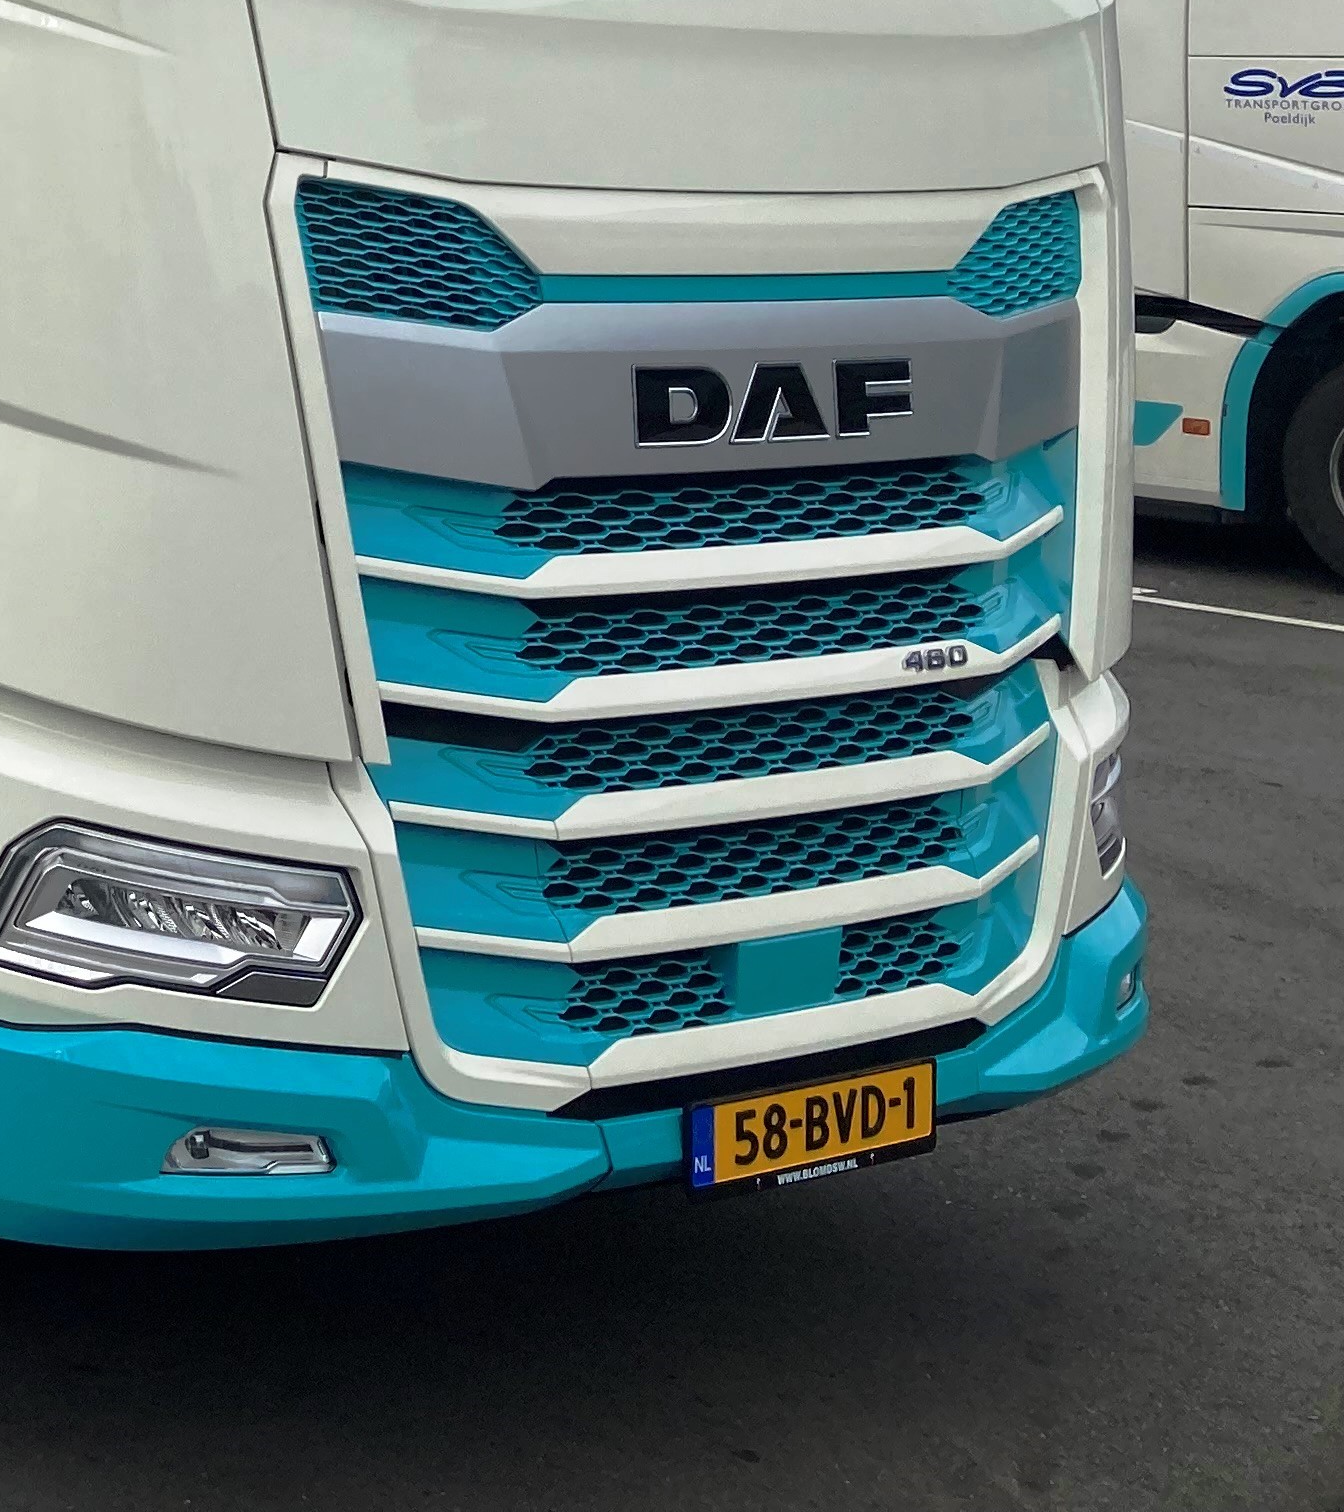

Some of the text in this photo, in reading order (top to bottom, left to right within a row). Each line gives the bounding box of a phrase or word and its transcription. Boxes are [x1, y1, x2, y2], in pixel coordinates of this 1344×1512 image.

[1223, 69, 1344, 98] SVB
[1264, 111, 1316, 127] Poeldijk
[631, 357, 914, 448] DAF
[734, 1076, 916, 1166] 58-BVD-1
[694, 1155, 712, 1174] NL
